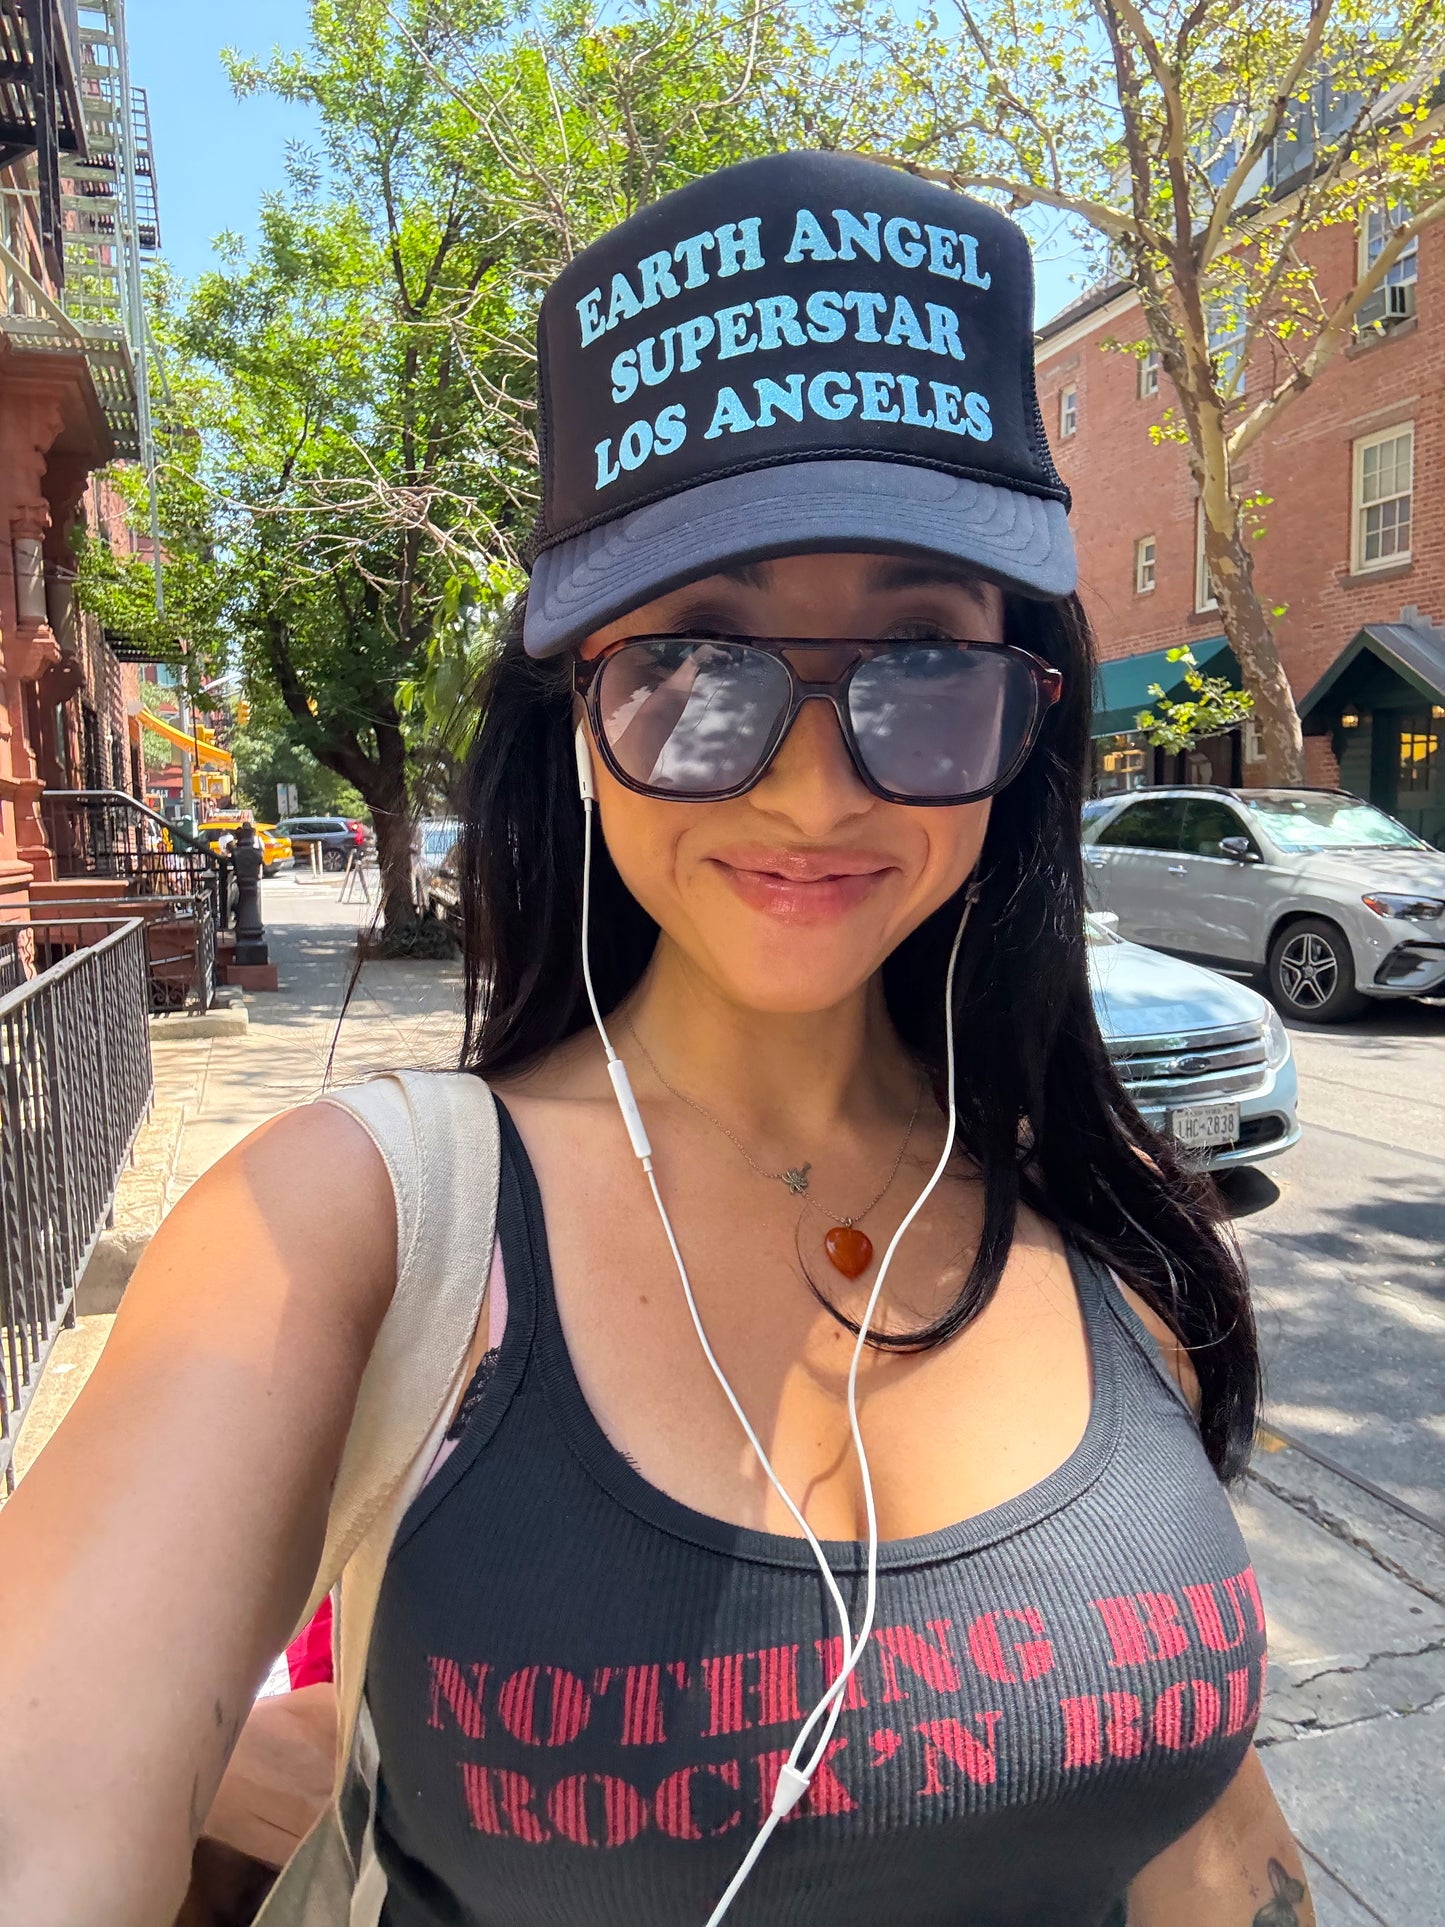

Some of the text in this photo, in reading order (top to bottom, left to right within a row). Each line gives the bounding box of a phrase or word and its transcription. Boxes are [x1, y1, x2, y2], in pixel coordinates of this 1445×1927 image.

[576, 209, 991, 348] EARTH ANGEL
[611, 290, 966, 403] SUPERSTAR
[594, 371, 994, 491] LOS ANGELES
[428, 1606, 1056, 1748] NOTHING
